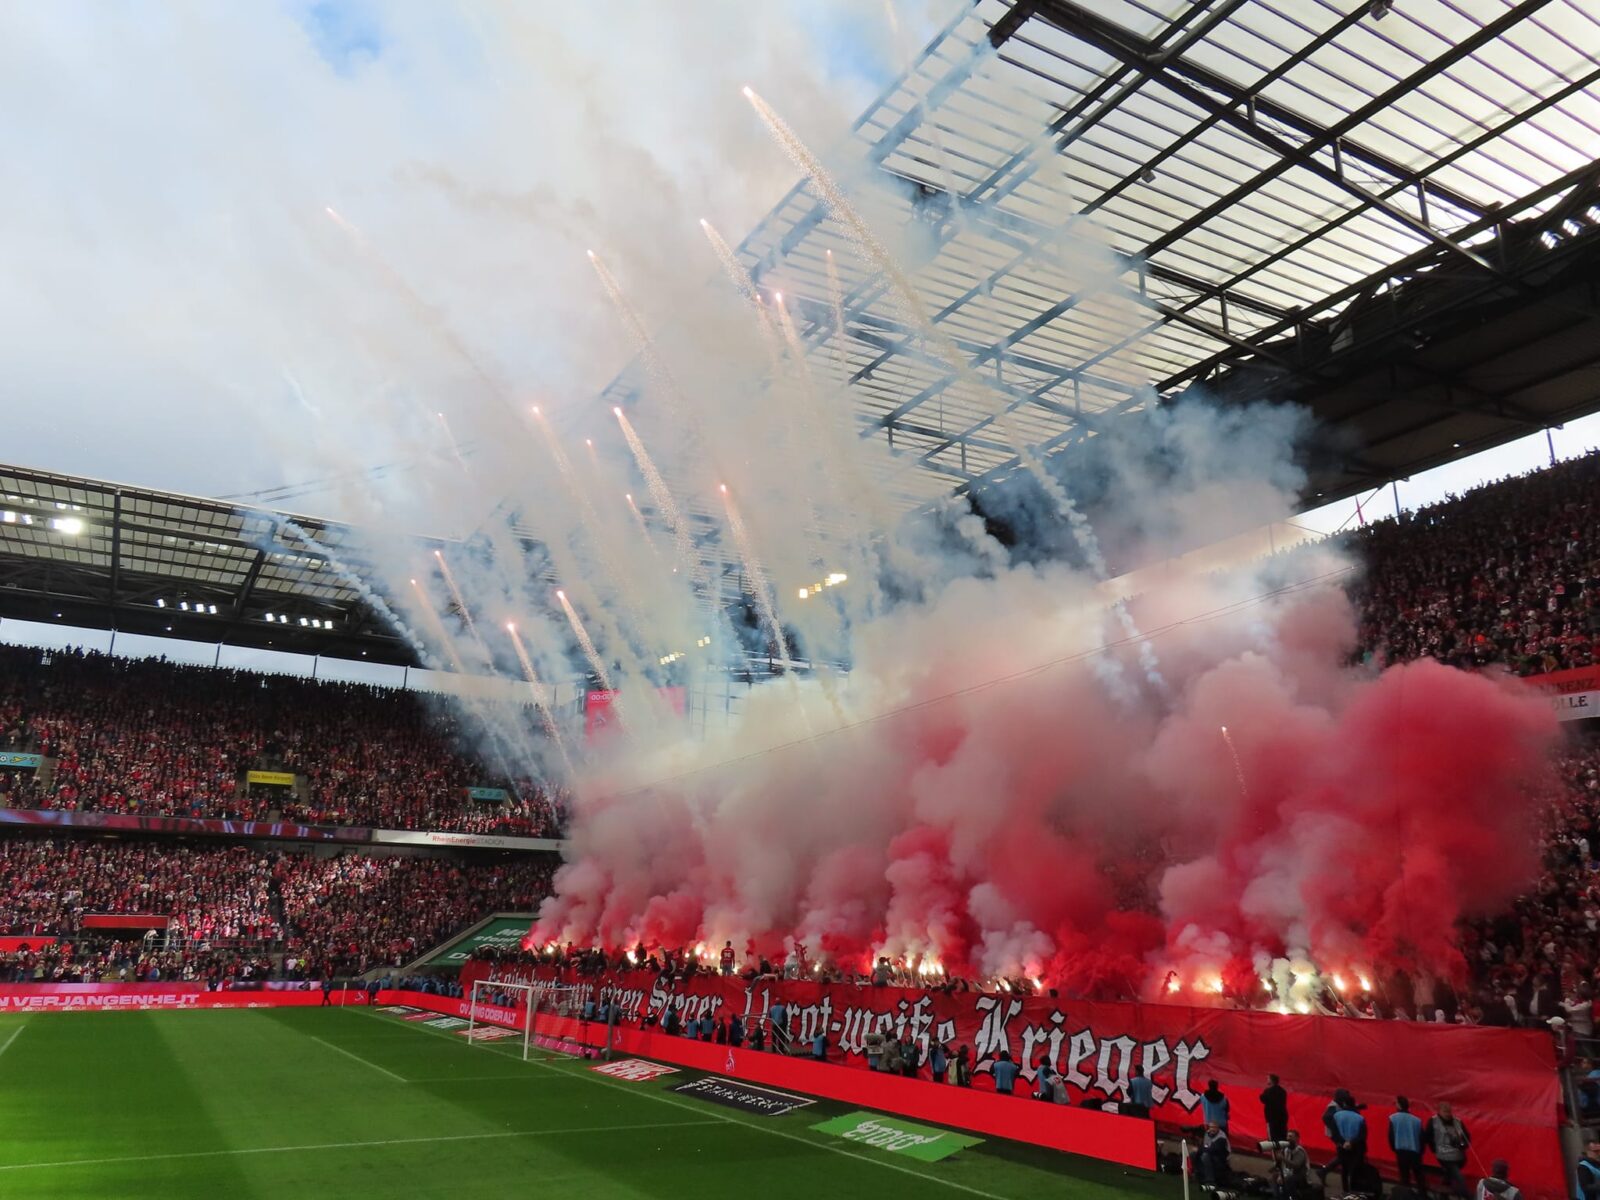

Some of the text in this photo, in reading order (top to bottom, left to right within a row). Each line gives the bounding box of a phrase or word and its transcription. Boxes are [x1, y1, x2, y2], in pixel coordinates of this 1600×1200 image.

[648, 976, 723, 1027] Sieger
[786, 995, 956, 1067] rot-weiße
[974, 997, 1210, 1113] Krieger
